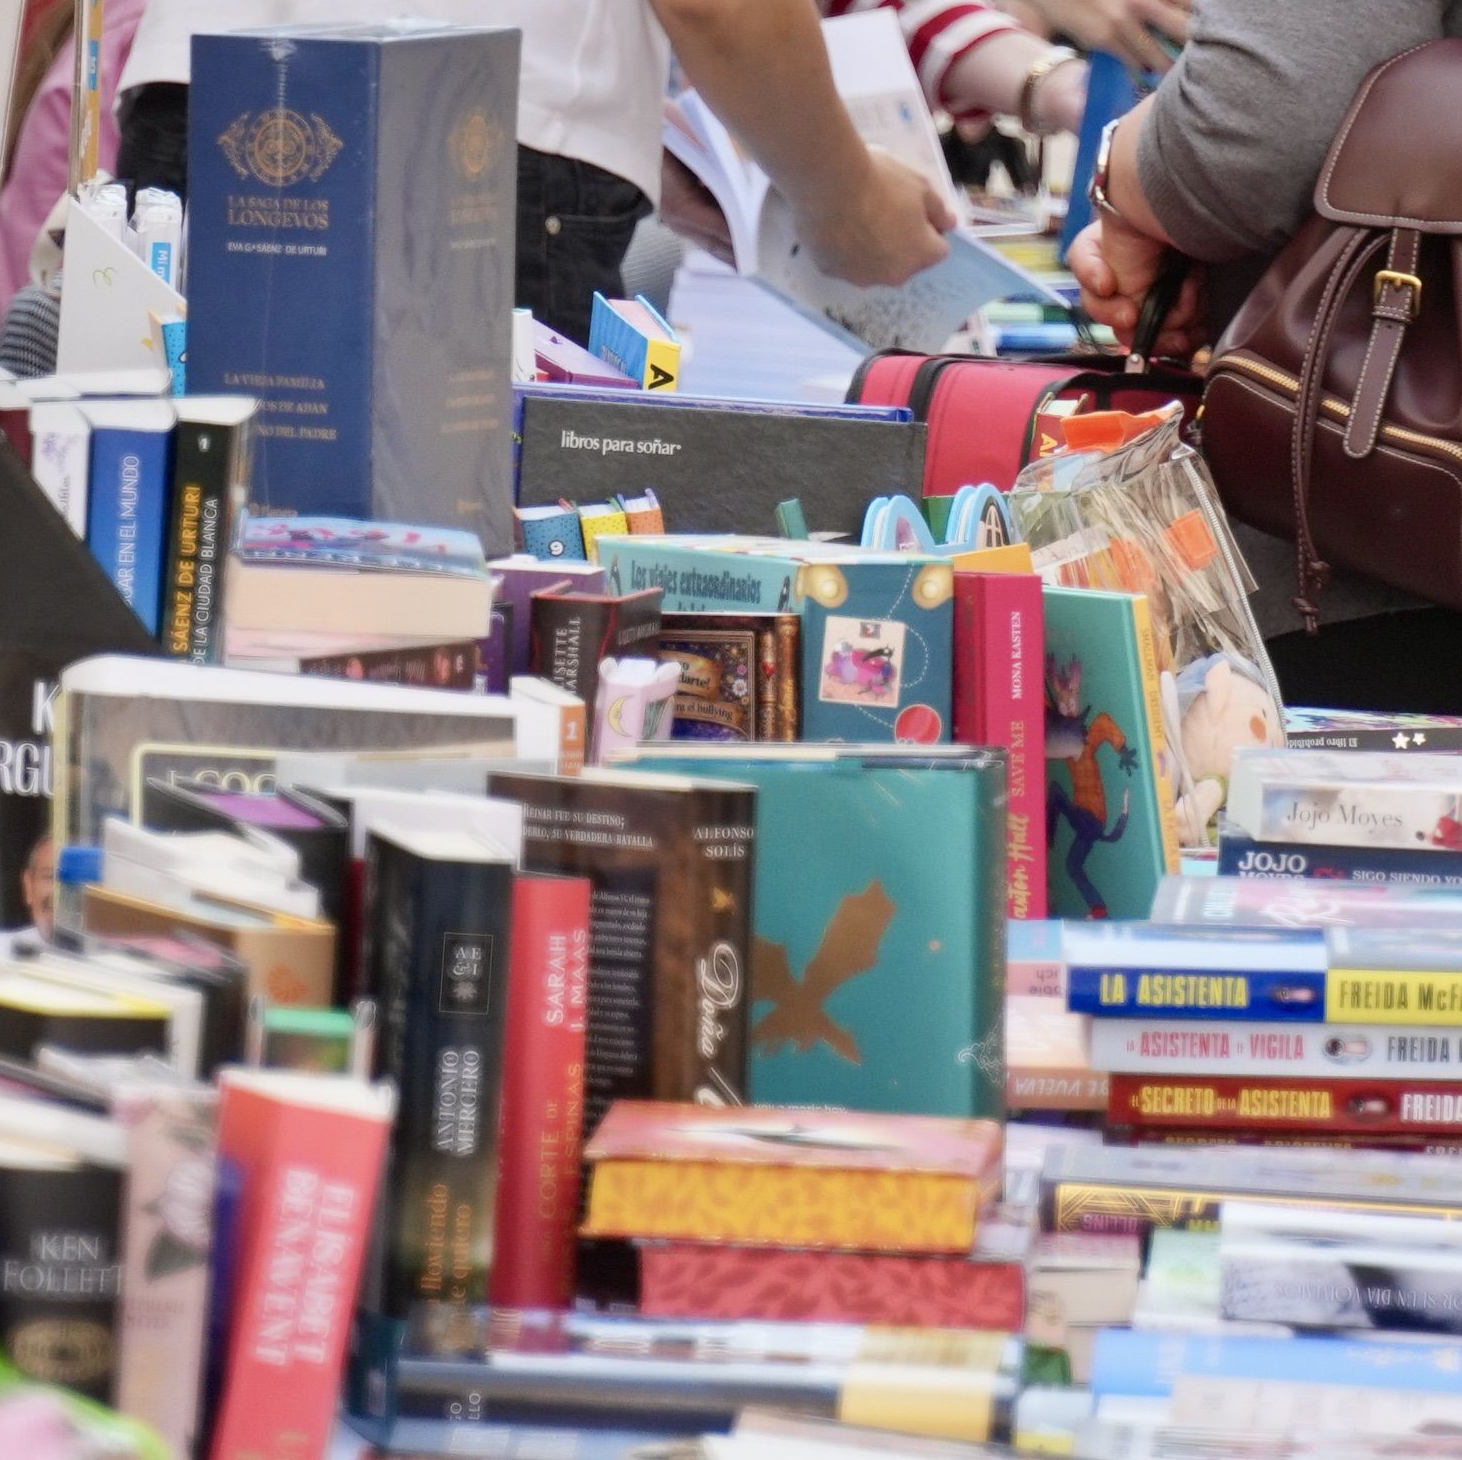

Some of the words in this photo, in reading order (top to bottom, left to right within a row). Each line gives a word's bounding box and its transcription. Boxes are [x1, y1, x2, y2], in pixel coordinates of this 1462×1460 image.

[228, 209, 329, 230] LONGEVOS
[560, 430, 600, 451] libros
[602, 437, 634, 455] para
[122, 455, 139, 520] MUNDO
[121, 521, 136, 539] EL
[181, 486, 201, 556] URTURI
[200, 498, 219, 559] BLANCA
[120, 544, 135, 564] EN
[179, 561, 195, 584] DE
[195, 563, 213, 622] CIUDAD
[172, 593, 194, 654] SÁENZ
[194, 623, 208, 644] LA
[1010, 610, 1022, 659] KASTEN
[1011, 660, 1024, 700] MONA
[33, 681, 54, 734] K
[1010, 719, 1024, 744] ME
[1287, 737, 1325, 749] prohibid
[1326, 737, 1347, 748] libro
[1011, 748, 1025, 797] SAVE
[693, 826, 754, 840] ALFONSO
[1286, 800, 1331, 832] Jojo
[1339, 803, 1403, 834] Moyes
[565, 830, 613, 845] VERDADERA
[705, 843, 745, 858] SOLÍS
[1238, 850, 1308, 873] JOJO
[547, 935, 566, 1024] SARAH
[570, 928, 586, 1005] MAAS
[1100, 974, 1126, 1006] LA
[1138, 974, 1248, 1008] ASISTENTA
[1339, 980, 1409, 1010] FREIDA
[1140, 1031, 1231, 1059] ASISTENTA
[1250, 1033, 1304, 1060] VIGILA
[1388, 1036, 1450, 1064] FREIDA
[437, 1051, 459, 1152] ANTONIO
[457, 1050, 480, 1153] MERCERO
[545, 1099, 558, 1119] DE
[1140, 1086, 1214, 1115] SECRETO
[1239, 1089, 1331, 1118] ASISTENTA
[539, 1130, 560, 1219] CORTE
[39, 1235, 99, 1260] KEN
[3, 1260, 123, 1293] FOLLETT
[255, 1168, 319, 1367] BENAVENT
